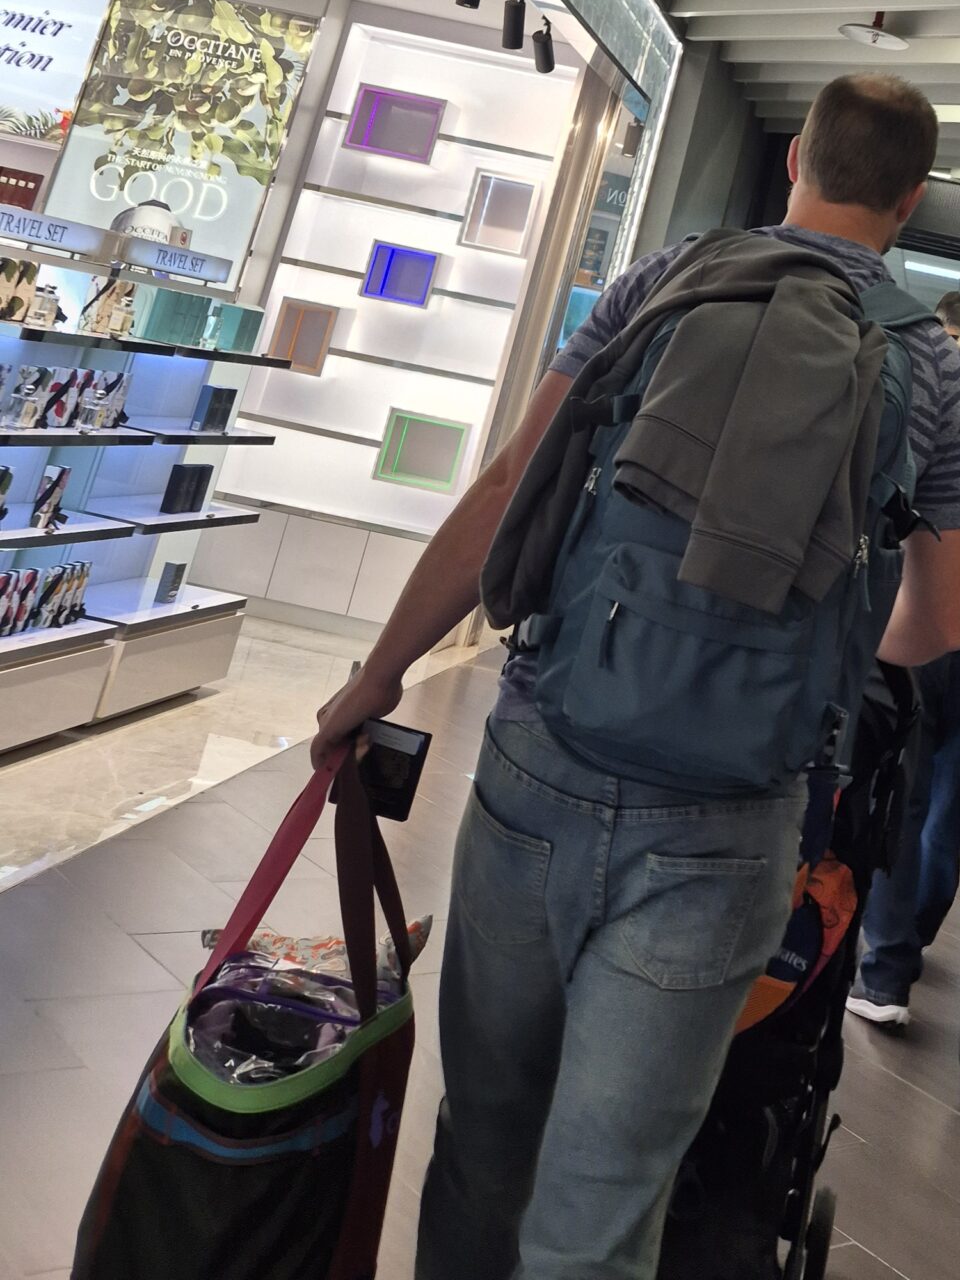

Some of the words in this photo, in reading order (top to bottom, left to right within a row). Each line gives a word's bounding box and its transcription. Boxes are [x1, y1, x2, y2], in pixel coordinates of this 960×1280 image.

[89, 163, 228, 221] GOOD
[0, 212, 44, 239] TRAVEL
[44, 224, 68, 243] SET
[156, 248, 188, 270] TRAVEL
[189, 255, 207, 274] SET
